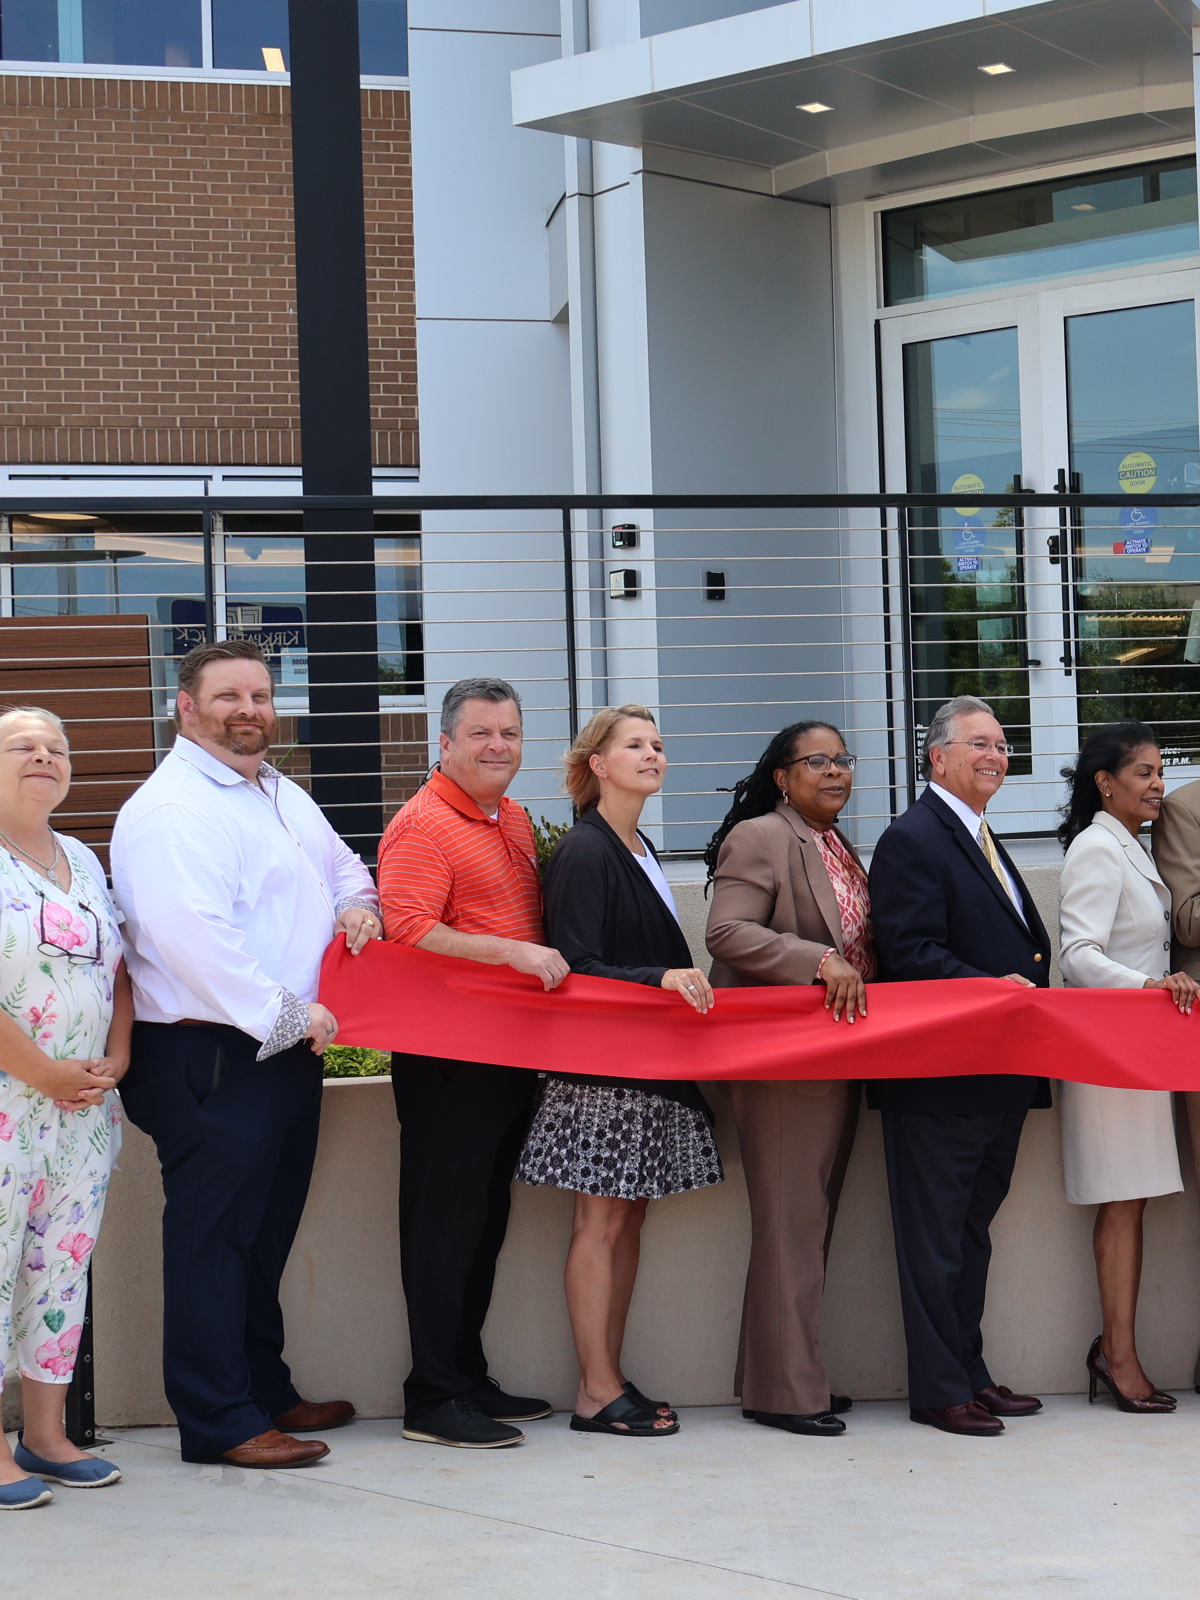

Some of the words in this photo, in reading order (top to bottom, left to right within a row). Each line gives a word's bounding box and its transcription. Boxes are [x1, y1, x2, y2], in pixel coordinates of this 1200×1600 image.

[1121, 461, 1153, 469] AUTOMATIC
[1120, 468, 1156, 480] CAUTION
[954, 483, 982, 491] AUTOMATIC
[1172, 757, 1191, 765] P.M.
